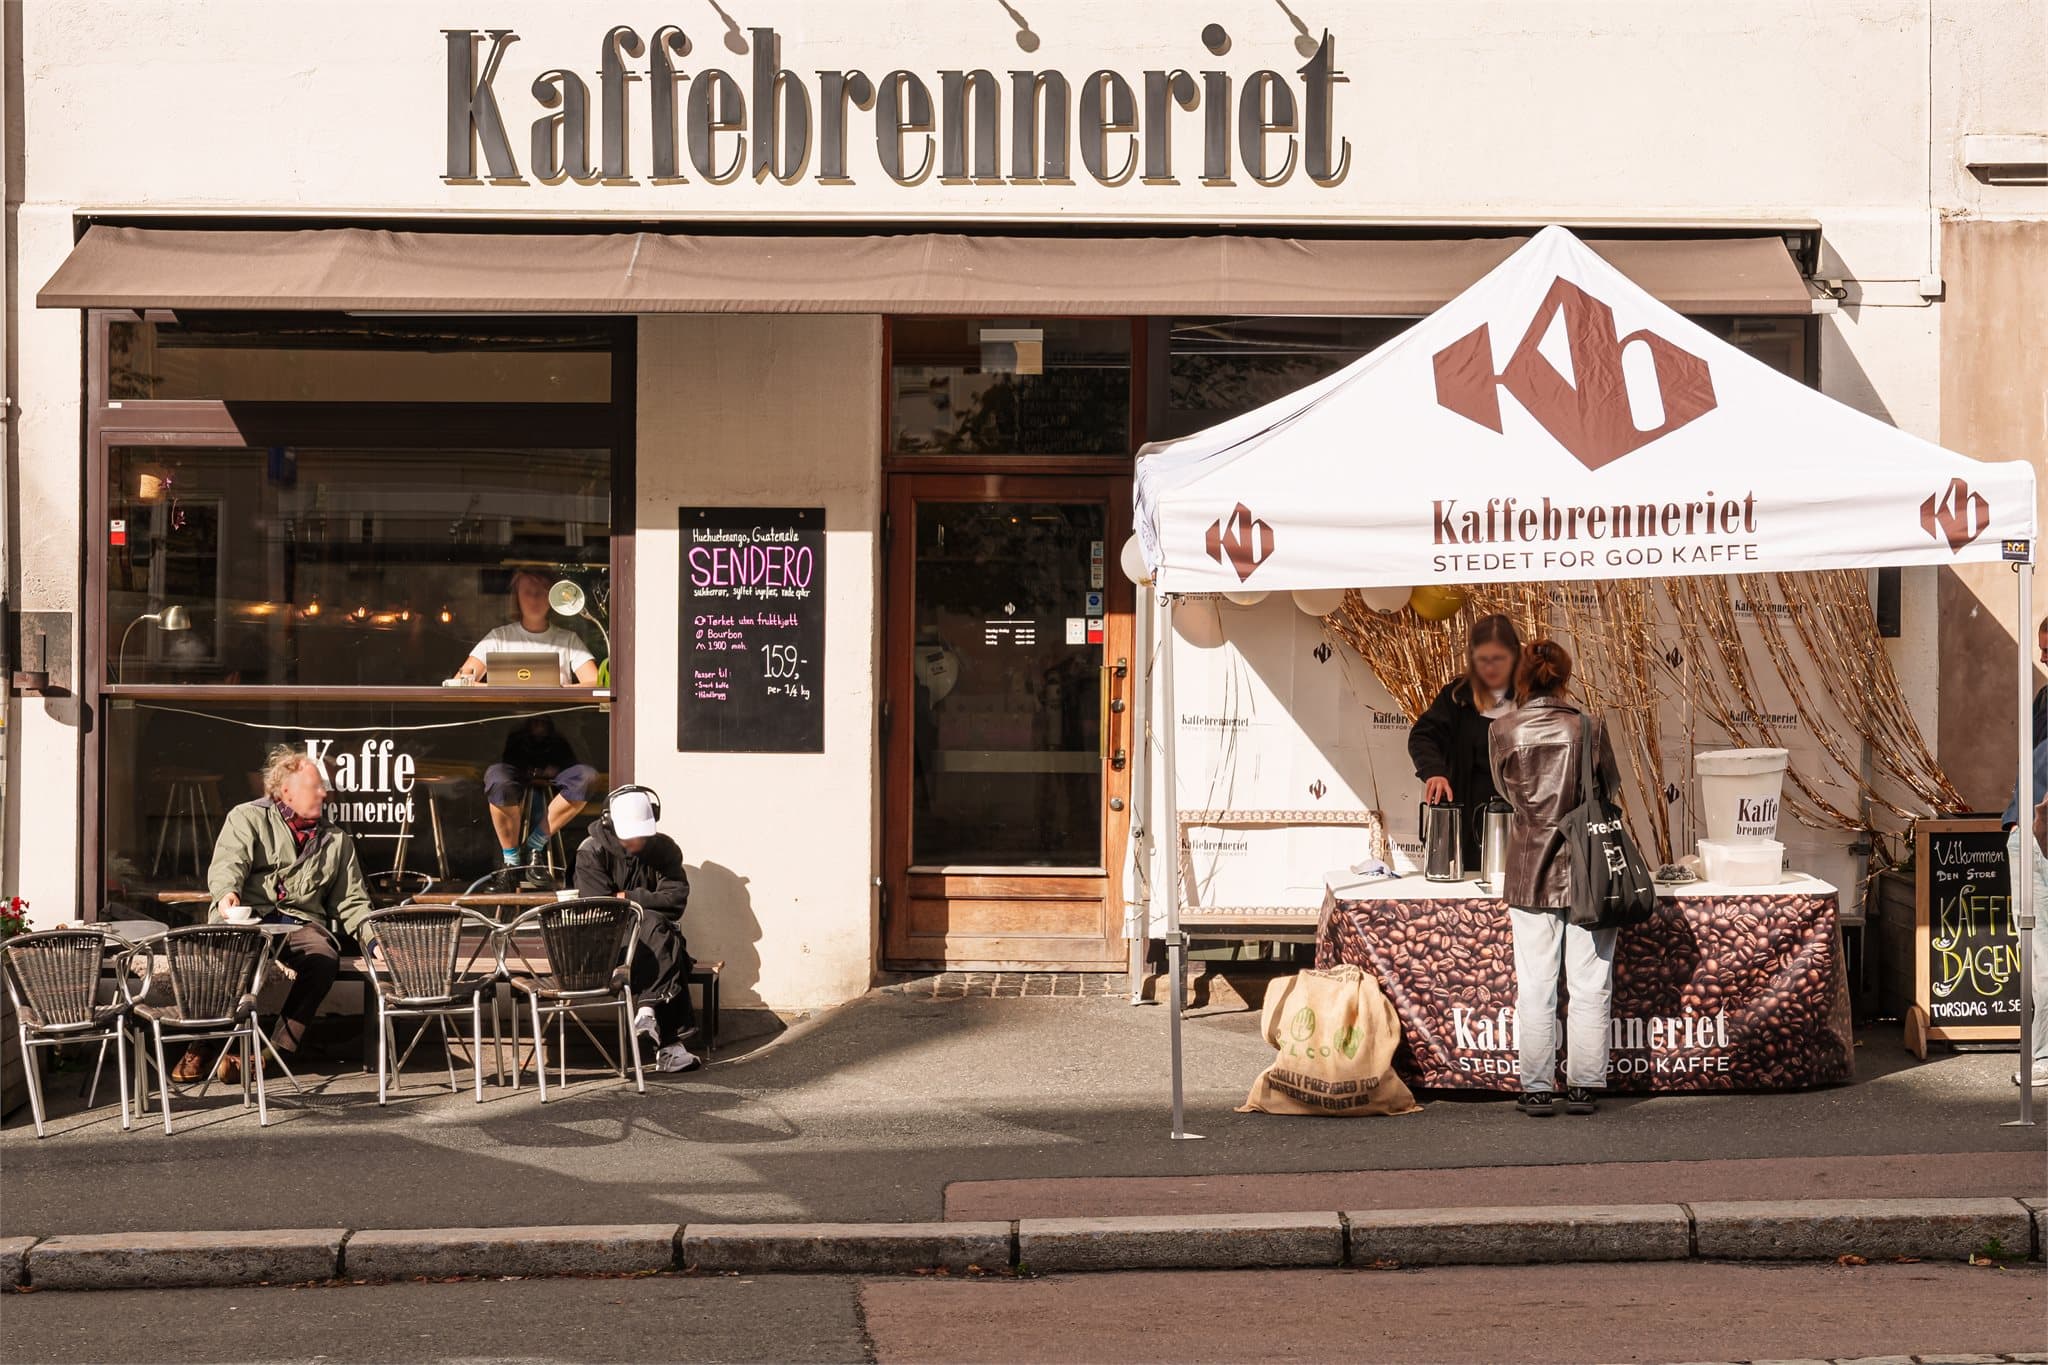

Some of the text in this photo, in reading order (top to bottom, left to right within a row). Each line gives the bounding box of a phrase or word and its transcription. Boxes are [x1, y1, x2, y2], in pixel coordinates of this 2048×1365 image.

[440, 26, 1346, 184] Kaffebrenneriet
[1431, 490, 1758, 545] Kaffebrenneriet
[752, 526, 799, 542] Guatemala
[688, 545, 813, 587] SENDERO
[1433, 544, 1759, 572] STEDET FOR GOD KAFFE
[706, 614, 735, 626] Tørket
[707, 628, 743, 639] Bourbon
[694, 670, 716, 679] Passer
[761, 643, 808, 680] 159,-
[767, 685, 783, 695] per
[800, 685, 811, 700] kg
[305, 739, 415, 793] Kaffe
[320, 793, 415, 824] renneriet
[1738, 798, 1777, 822] Kaffe
[1934, 840, 2005, 866] Velkommen
[1932, 944, 2021, 997] DAGEN
[1930, 1001, 1988, 1018] TORSDAG
[2008, 999, 2021, 1012] SE
[1451, 1006, 1729, 1050] Kaffnneriet
[1459, 1056, 1520, 1075] STEDE
[1656, 1056, 1729, 1073] KAFFE
